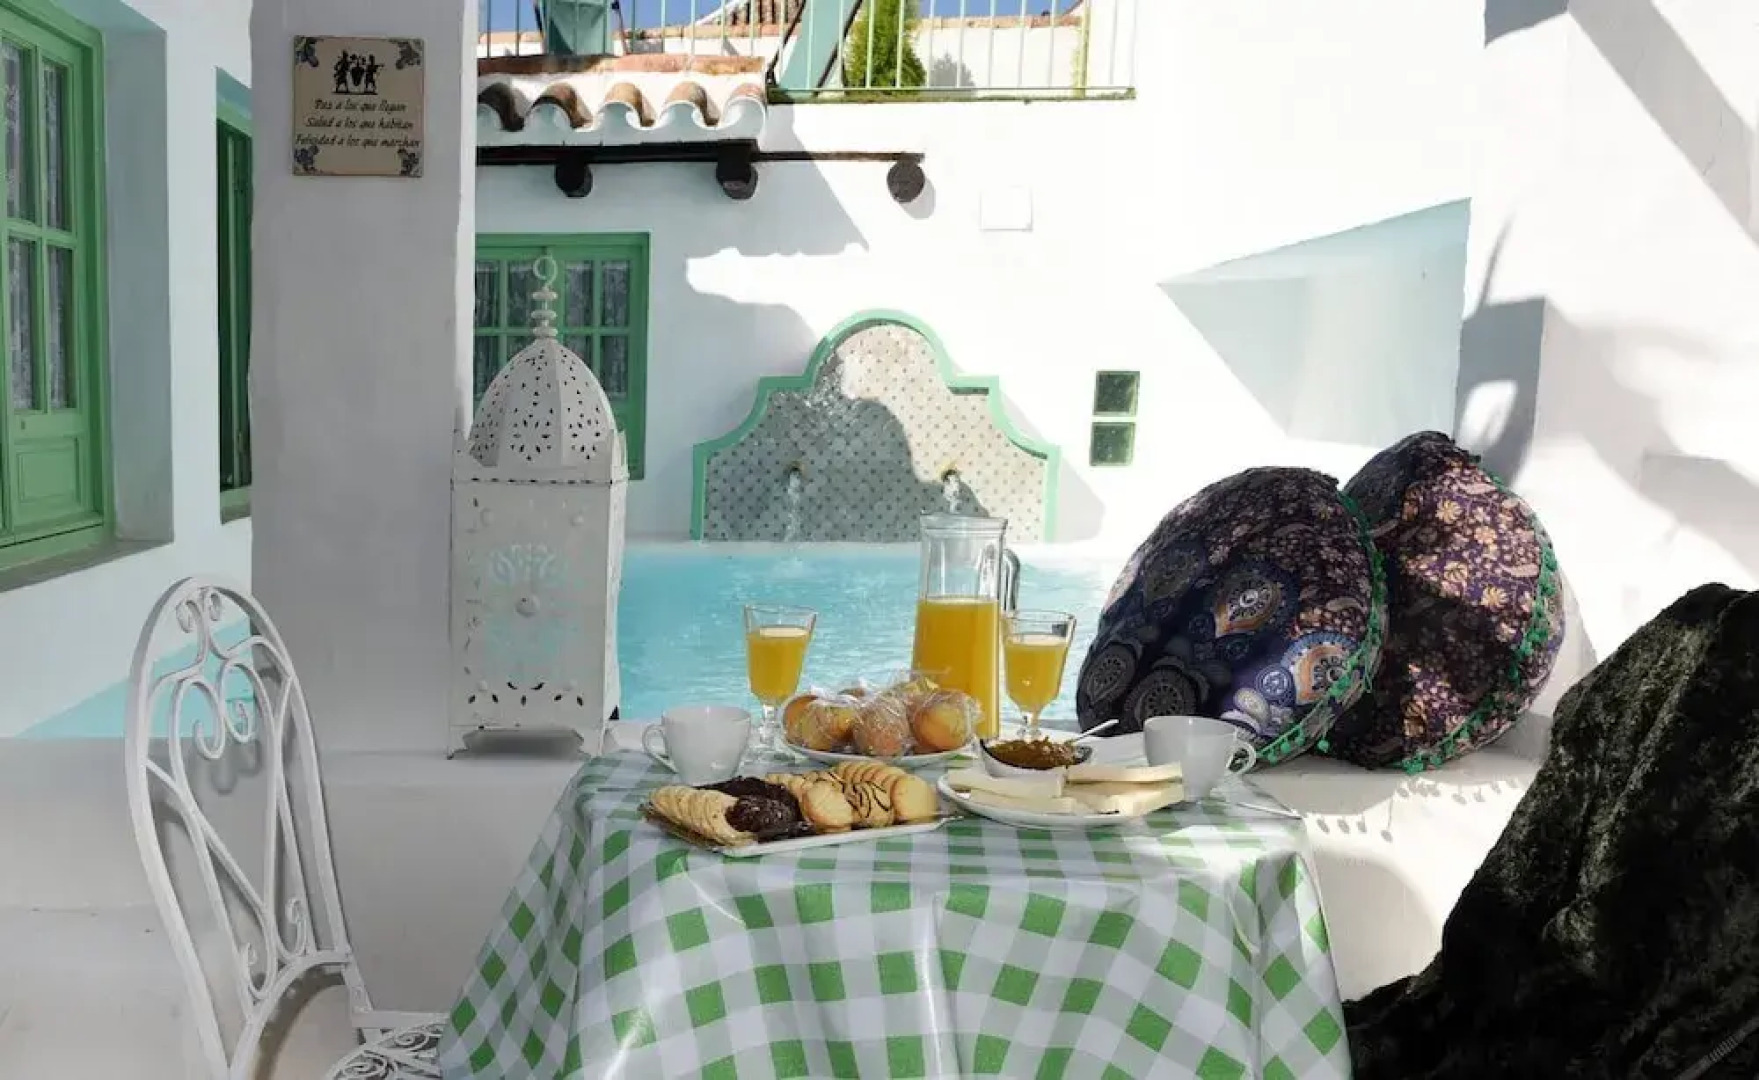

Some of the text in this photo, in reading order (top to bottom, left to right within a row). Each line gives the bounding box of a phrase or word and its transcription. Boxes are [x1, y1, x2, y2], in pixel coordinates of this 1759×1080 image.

[335, 102, 342, 110] a
[344, 98, 357, 110] los
[360, 102, 376, 112] que
[305, 116, 414, 129] Salud a los que habitan
[337, 137, 344, 145] a
[346, 134, 360, 146] los
[362, 138, 379, 149] que
[380, 136, 421, 147] marchan
